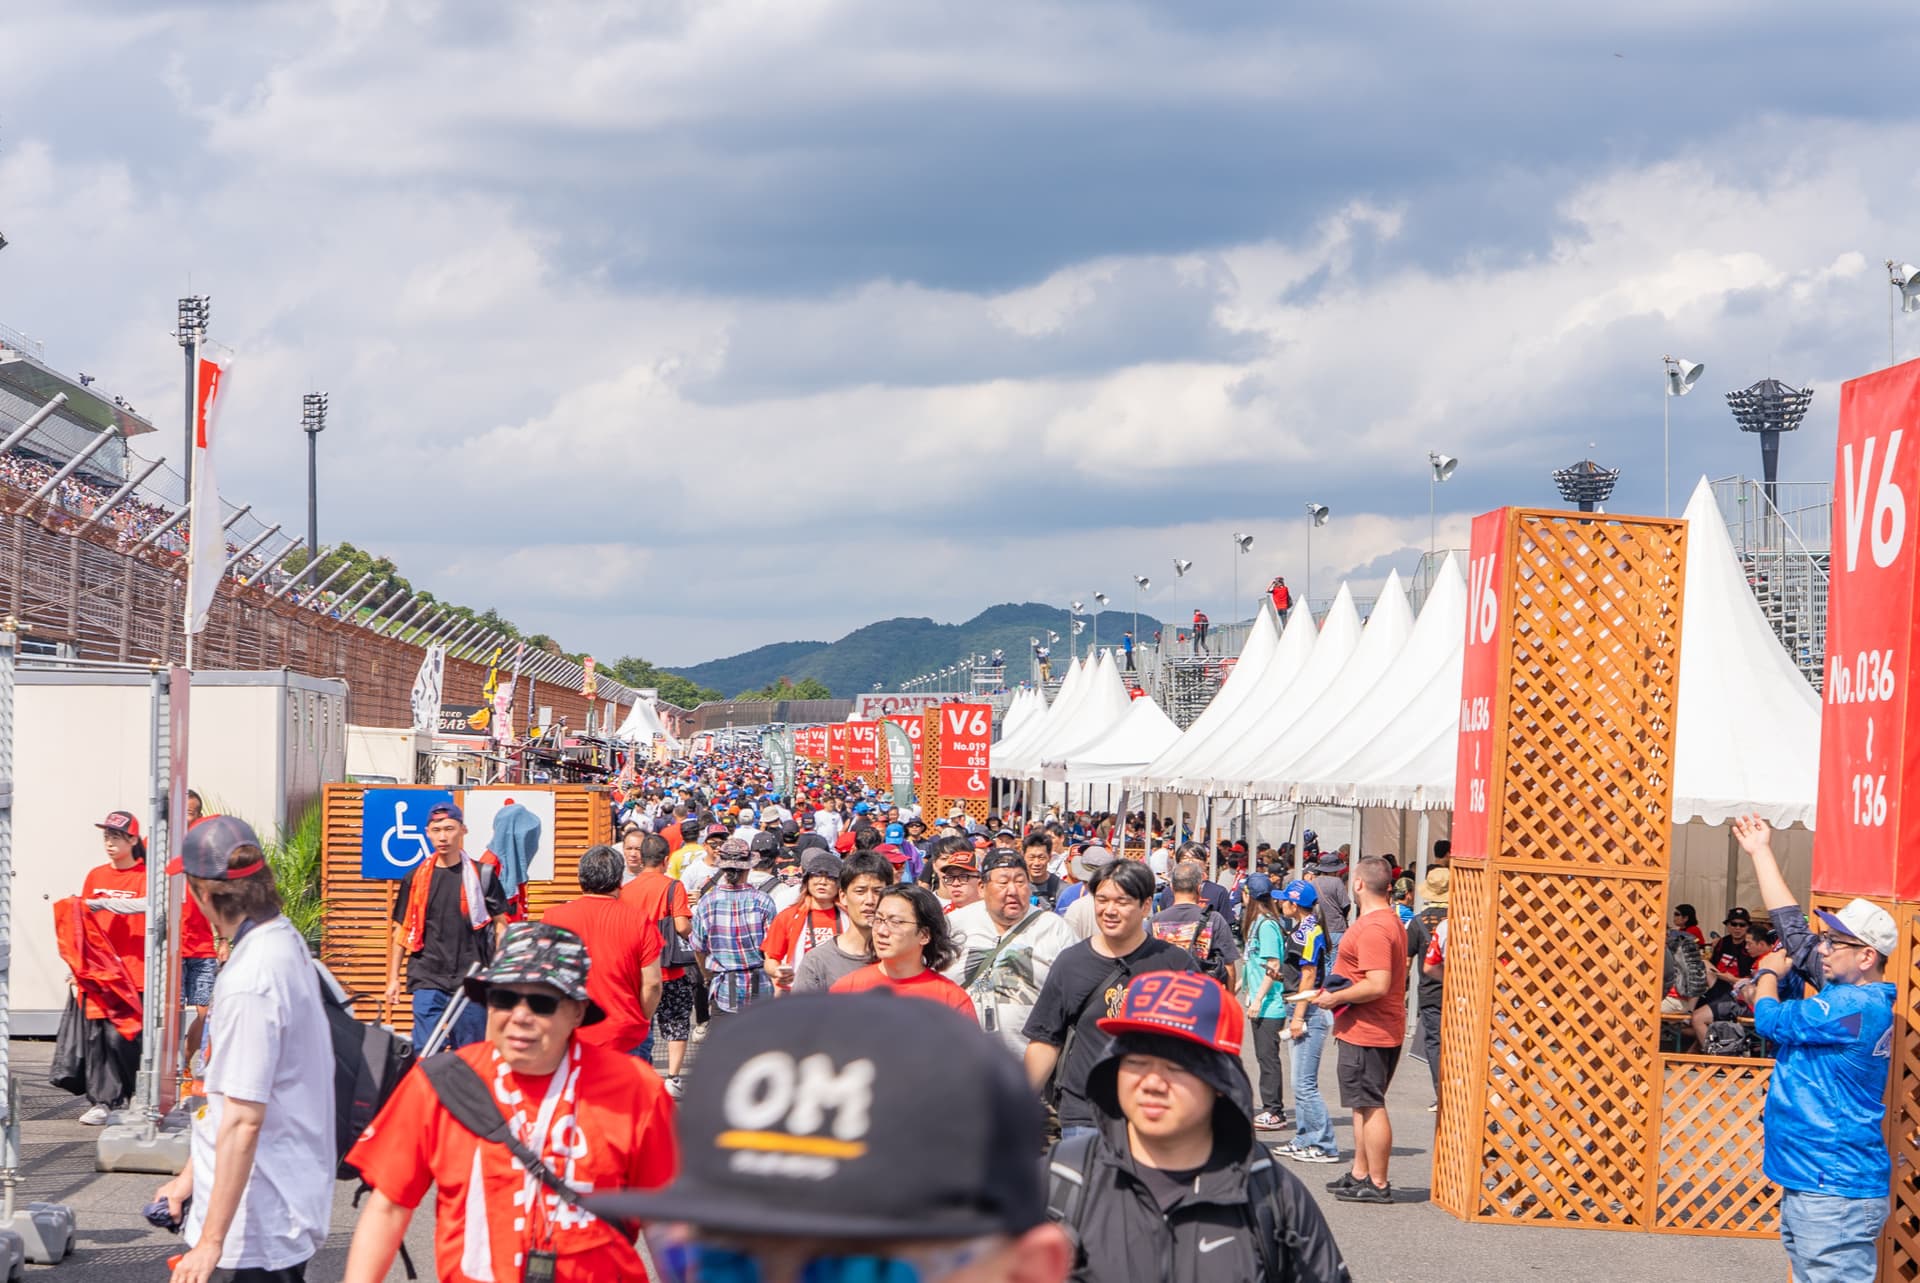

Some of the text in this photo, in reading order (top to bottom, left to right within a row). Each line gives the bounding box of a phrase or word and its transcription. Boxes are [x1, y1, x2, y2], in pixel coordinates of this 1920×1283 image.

[1844, 429, 1906, 573] V6
[1470, 552, 1498, 646] V6
[1829, 649, 1895, 704] No.036
[852, 726, 874, 741] V5
[948, 709, 988, 736] V6
[953, 741, 987, 753] No.019
[968, 757, 987, 766] 035
[1469, 778, 1485, 813] 136
[1852, 764, 1888, 827] 136
[805, 927, 833, 935] FRZA
[724, 1050, 876, 1140] OM
